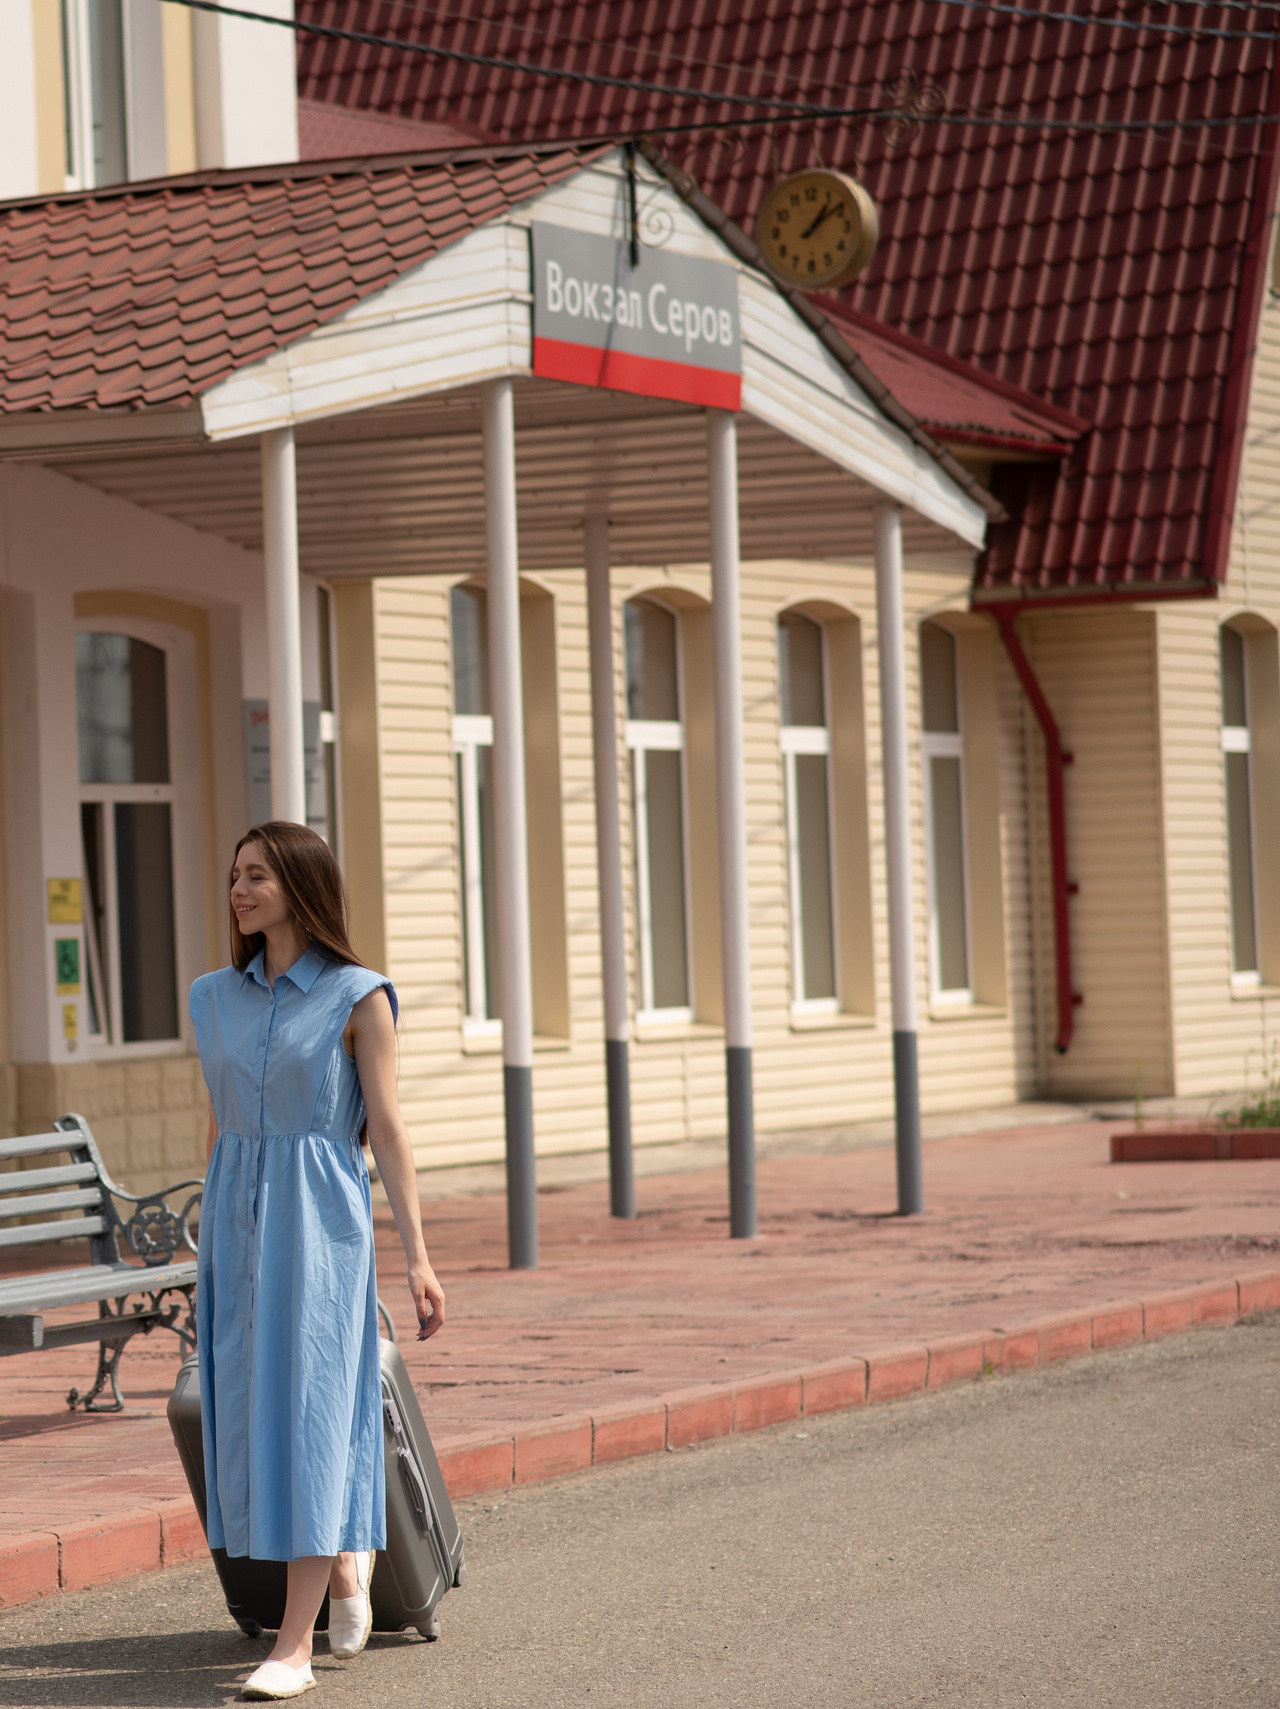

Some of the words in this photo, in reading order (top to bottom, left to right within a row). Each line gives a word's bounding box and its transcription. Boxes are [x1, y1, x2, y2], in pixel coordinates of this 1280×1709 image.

[790, 194, 799, 208] 11
[804, 187, 817, 202] 12
[776, 209, 789, 223] 10
[772, 227, 780, 241] 9
[843, 220, 851, 234] 3
[778, 244, 787, 258] 8
[836, 240, 845, 252] 4
[792, 255, 799, 271] 7
[807, 259, 816, 273] 6
[823, 253, 832, 267] 5
[546, 260, 643, 330] Вокзал
[648, 283, 733, 353] Серов
